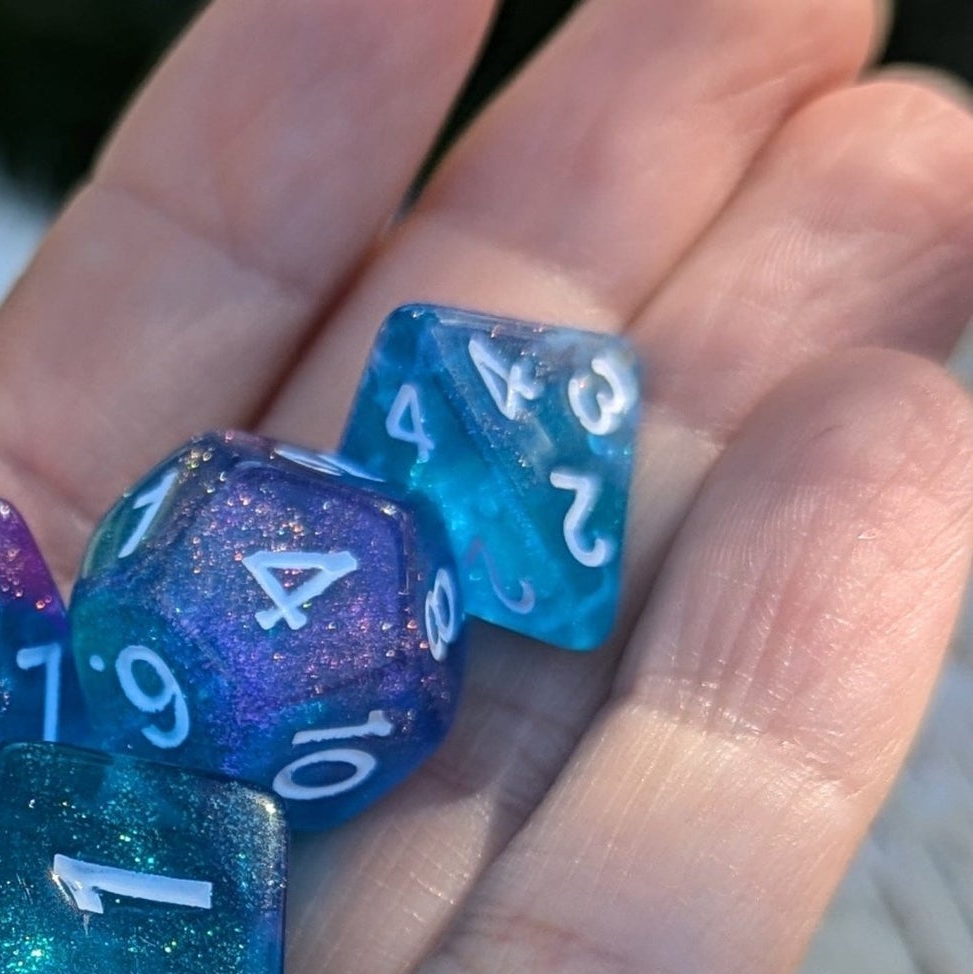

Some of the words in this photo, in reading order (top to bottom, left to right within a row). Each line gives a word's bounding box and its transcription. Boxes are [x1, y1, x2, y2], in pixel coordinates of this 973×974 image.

[468, 334, 545, 421] 4
[568, 356, 639, 436] 3
[386, 384, 435, 464] 4
[117, 469, 180, 559] 1
[550, 470, 617, 568] 2
[241, 550, 359, 631] 4
[272, 709, 394, 799] 10
[52, 853, 214, 914] 1
